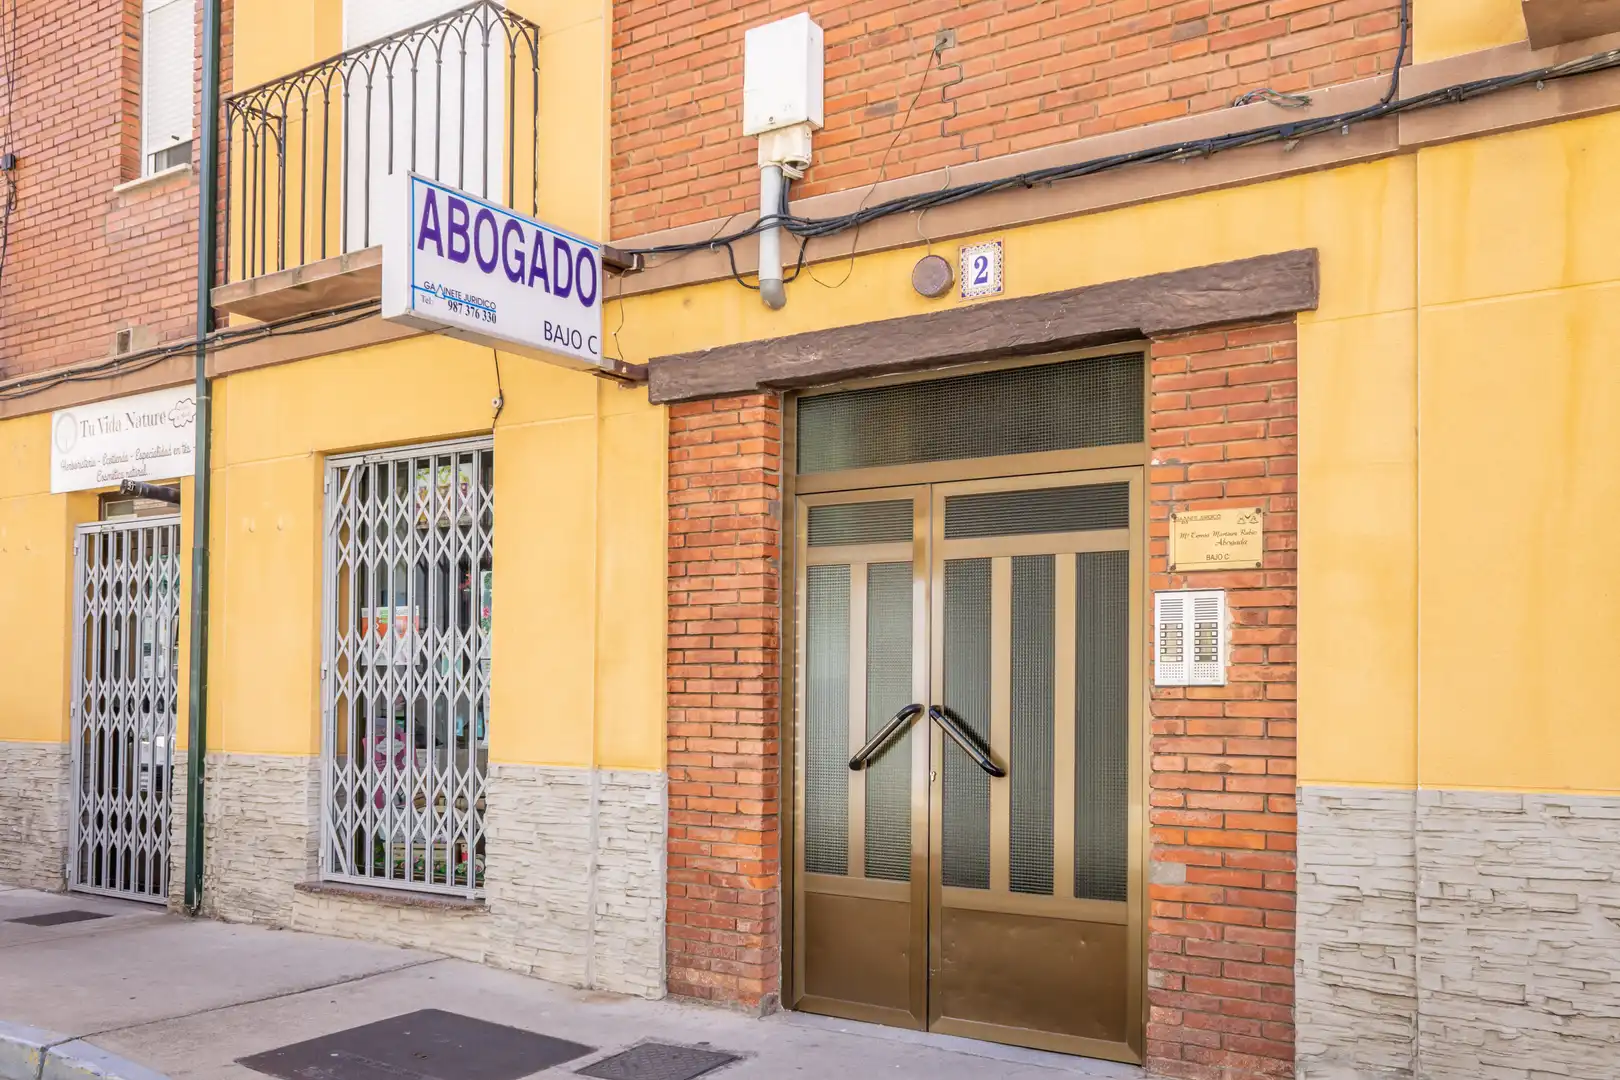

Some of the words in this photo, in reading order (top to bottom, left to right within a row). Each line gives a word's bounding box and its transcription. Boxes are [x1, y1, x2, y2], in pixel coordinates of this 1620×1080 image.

[417, 187, 597, 307] ABOGADO
[973, 255, 988, 285] 2
[447, 300, 463, 315] 987
[464, 305, 480, 319] 376
[482, 310, 497, 324] 330
[543, 320, 582, 350] BAJO
[587, 335, 598, 354] C
[79, 419, 96, 437] Tu
[97, 413, 122, 435] Vida
[124, 411, 166, 431] Nature
[1206, 553, 1223, 561] BAJO
